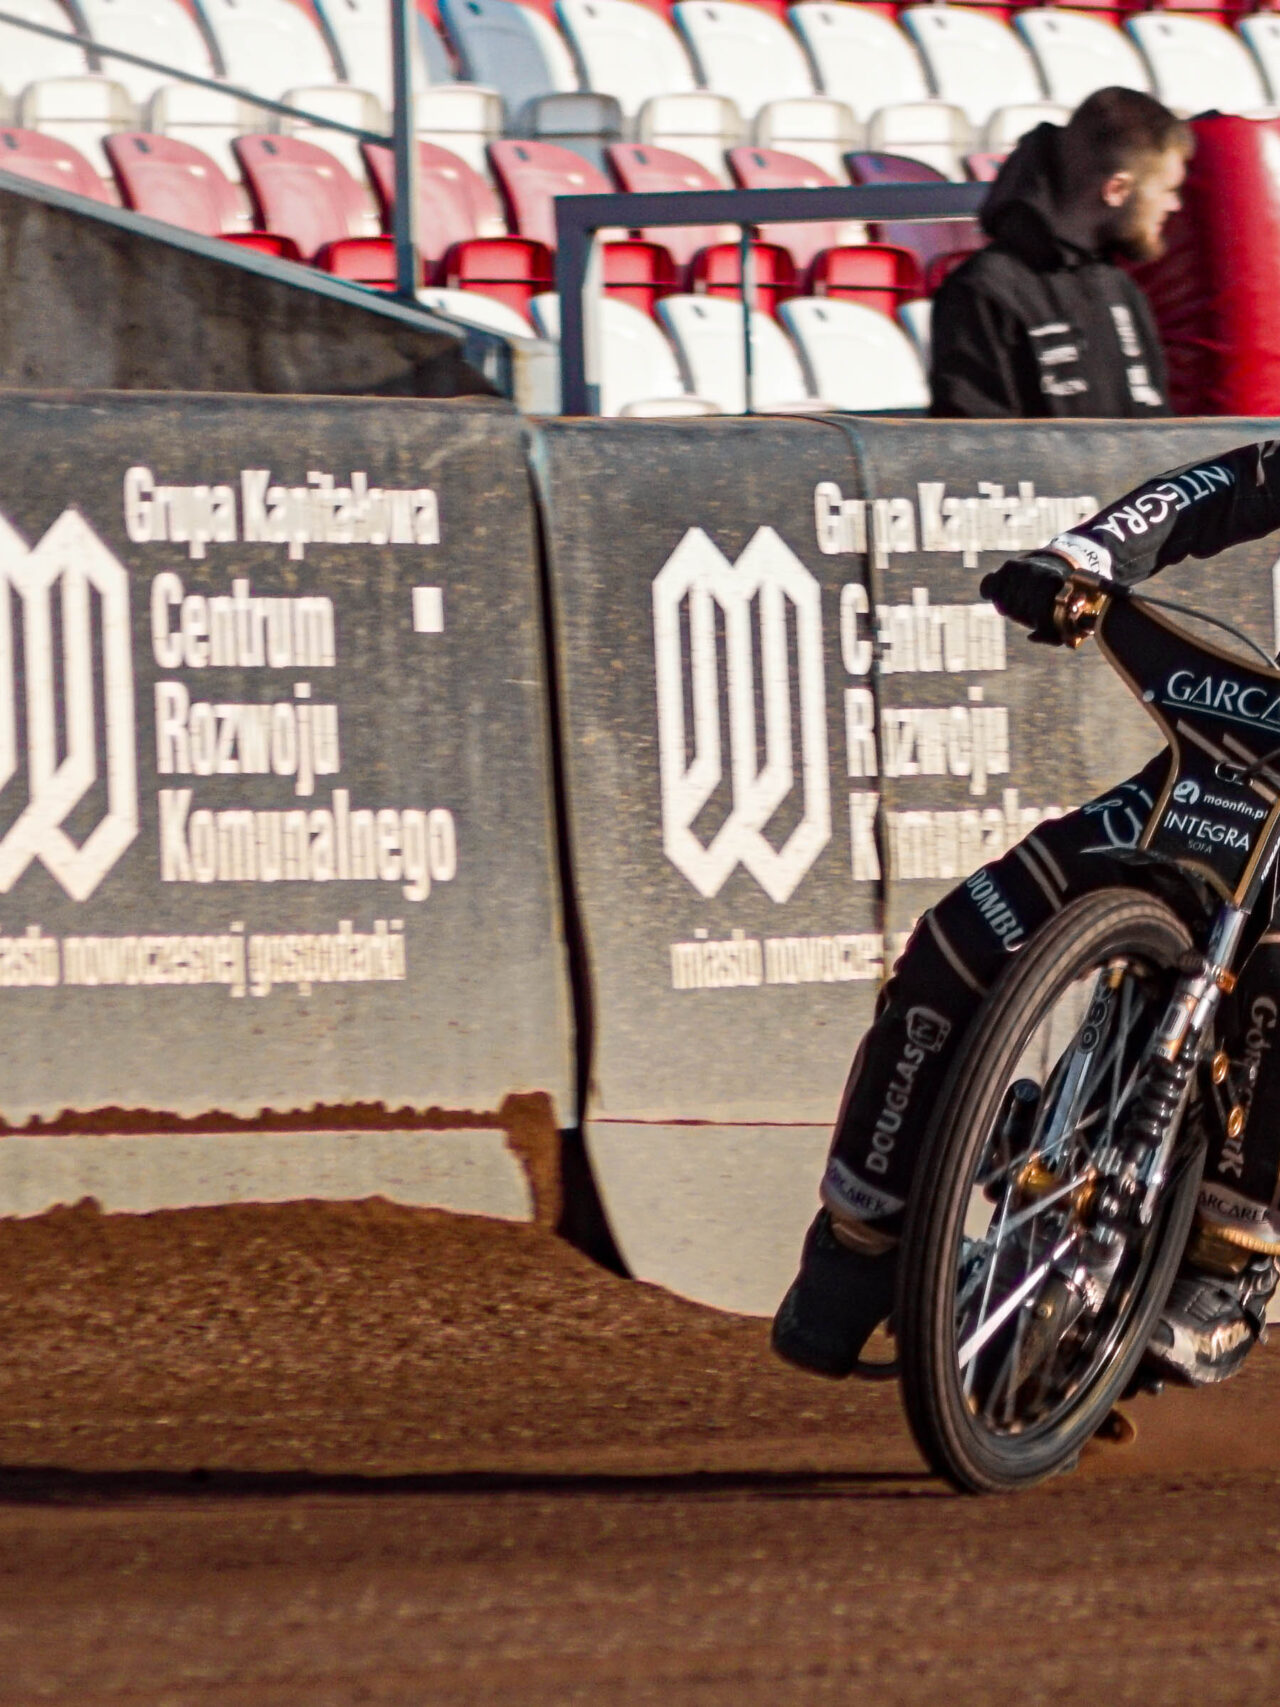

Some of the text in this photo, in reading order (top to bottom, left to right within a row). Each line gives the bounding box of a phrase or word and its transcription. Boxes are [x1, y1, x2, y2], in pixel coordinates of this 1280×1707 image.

[151, 572, 336, 667] Centrum
[155, 682, 340, 796] Rozwoju
[158, 789, 457, 901] Komunalnego
[1163, 810, 1249, 851] INTEGRA
[1203, 793, 1268, 821] moonfin.pl
[966, 868, 1028, 952] DOMBU
[865, 1043, 925, 1175] DOUGLAS
[1198, 1191, 1270, 1224] ARCAREK
